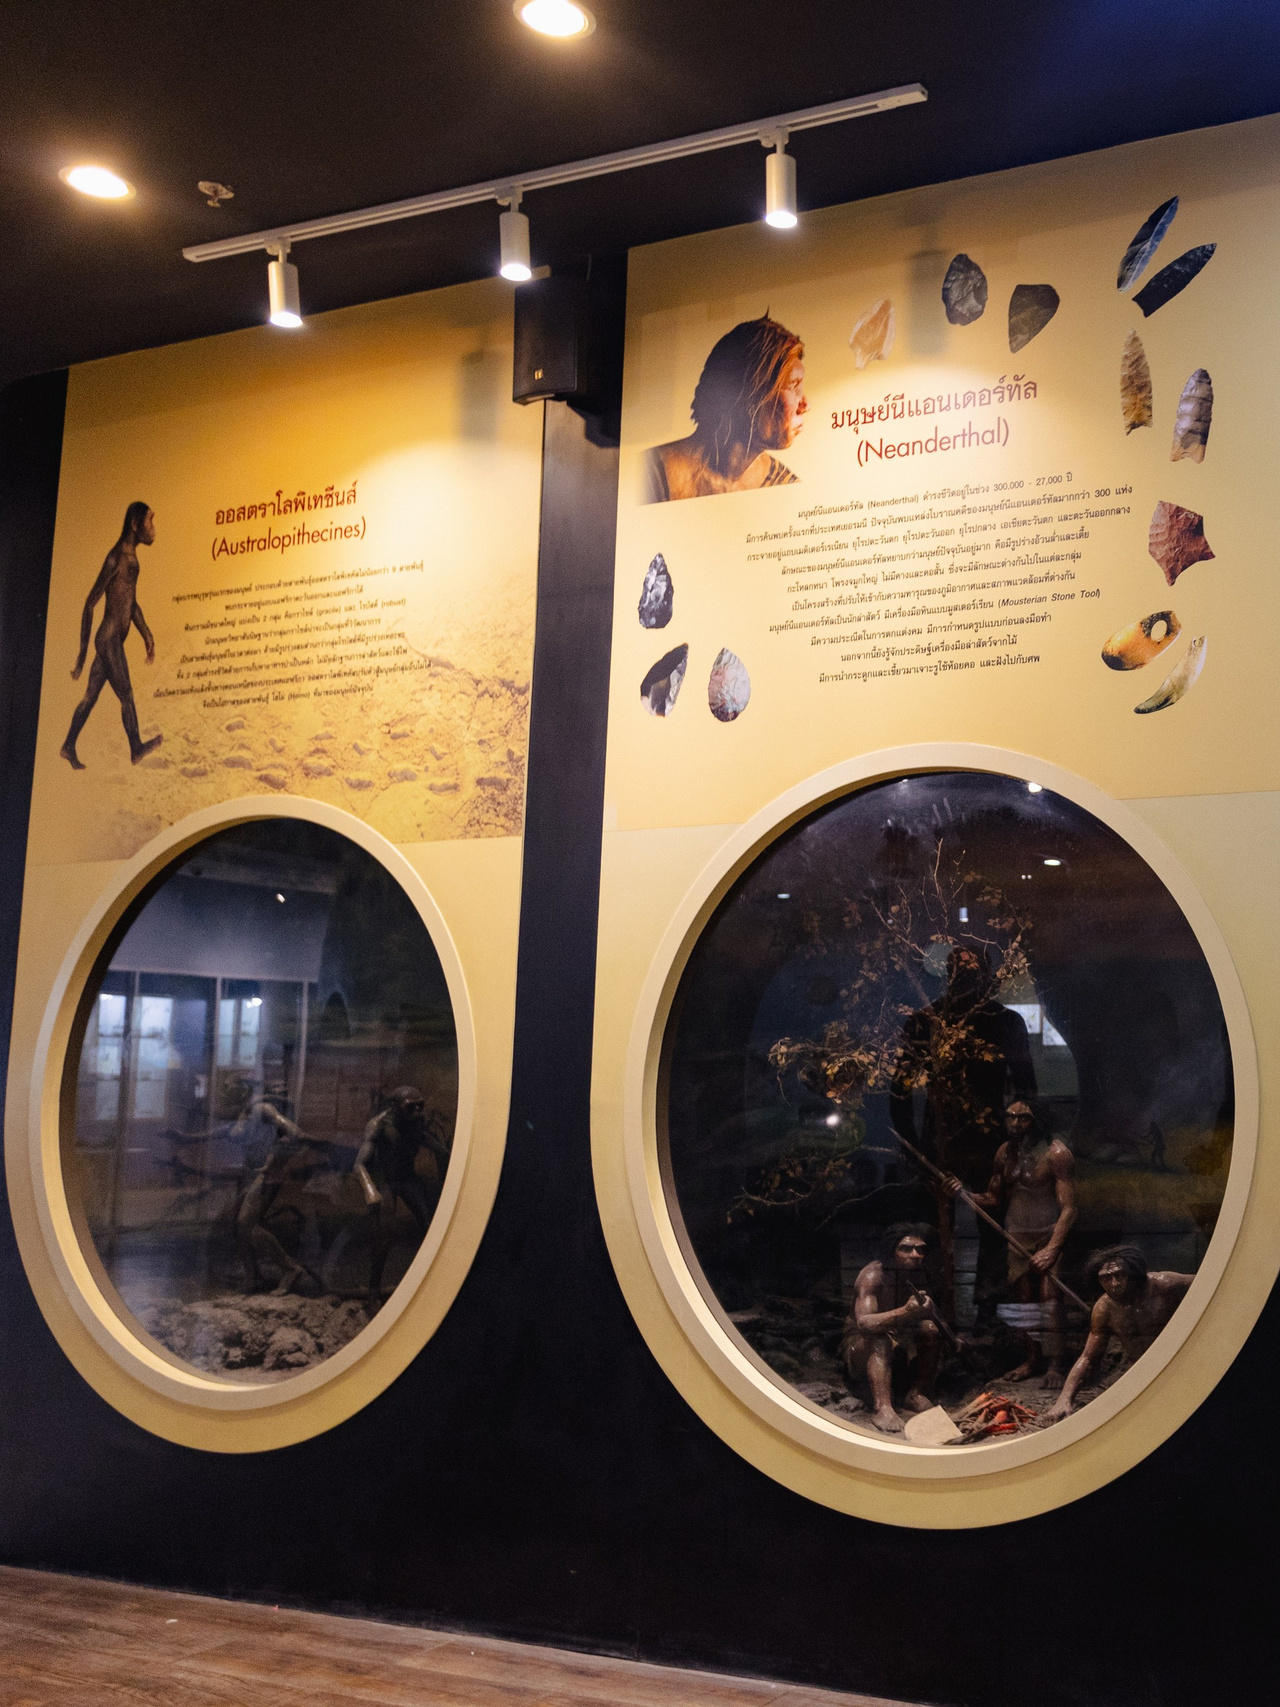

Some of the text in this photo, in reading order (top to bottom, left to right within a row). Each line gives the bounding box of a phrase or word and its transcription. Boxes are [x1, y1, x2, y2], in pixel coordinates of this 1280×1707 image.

[830, 374, 1038, 432] มนุษย์นีแอนเดอร์ทัล
[856, 417, 1010, 467] (Neanderthal)
[214, 481, 358, 525] ออสตราโลพิเทซีนส์
[866, 493, 920, 510] (Neanderthal)
[992, 479, 1025, 492] 300,000
[1035, 474, 1064, 487] 27,000
[1093, 487, 1112, 499] 300
[210, 517, 367, 560] (Australopithecines)
[997, 595, 1048, 609] (Mousterian
[1050, 591, 1076, 602] Stone
[1079, 587, 1101, 599] Tool)
